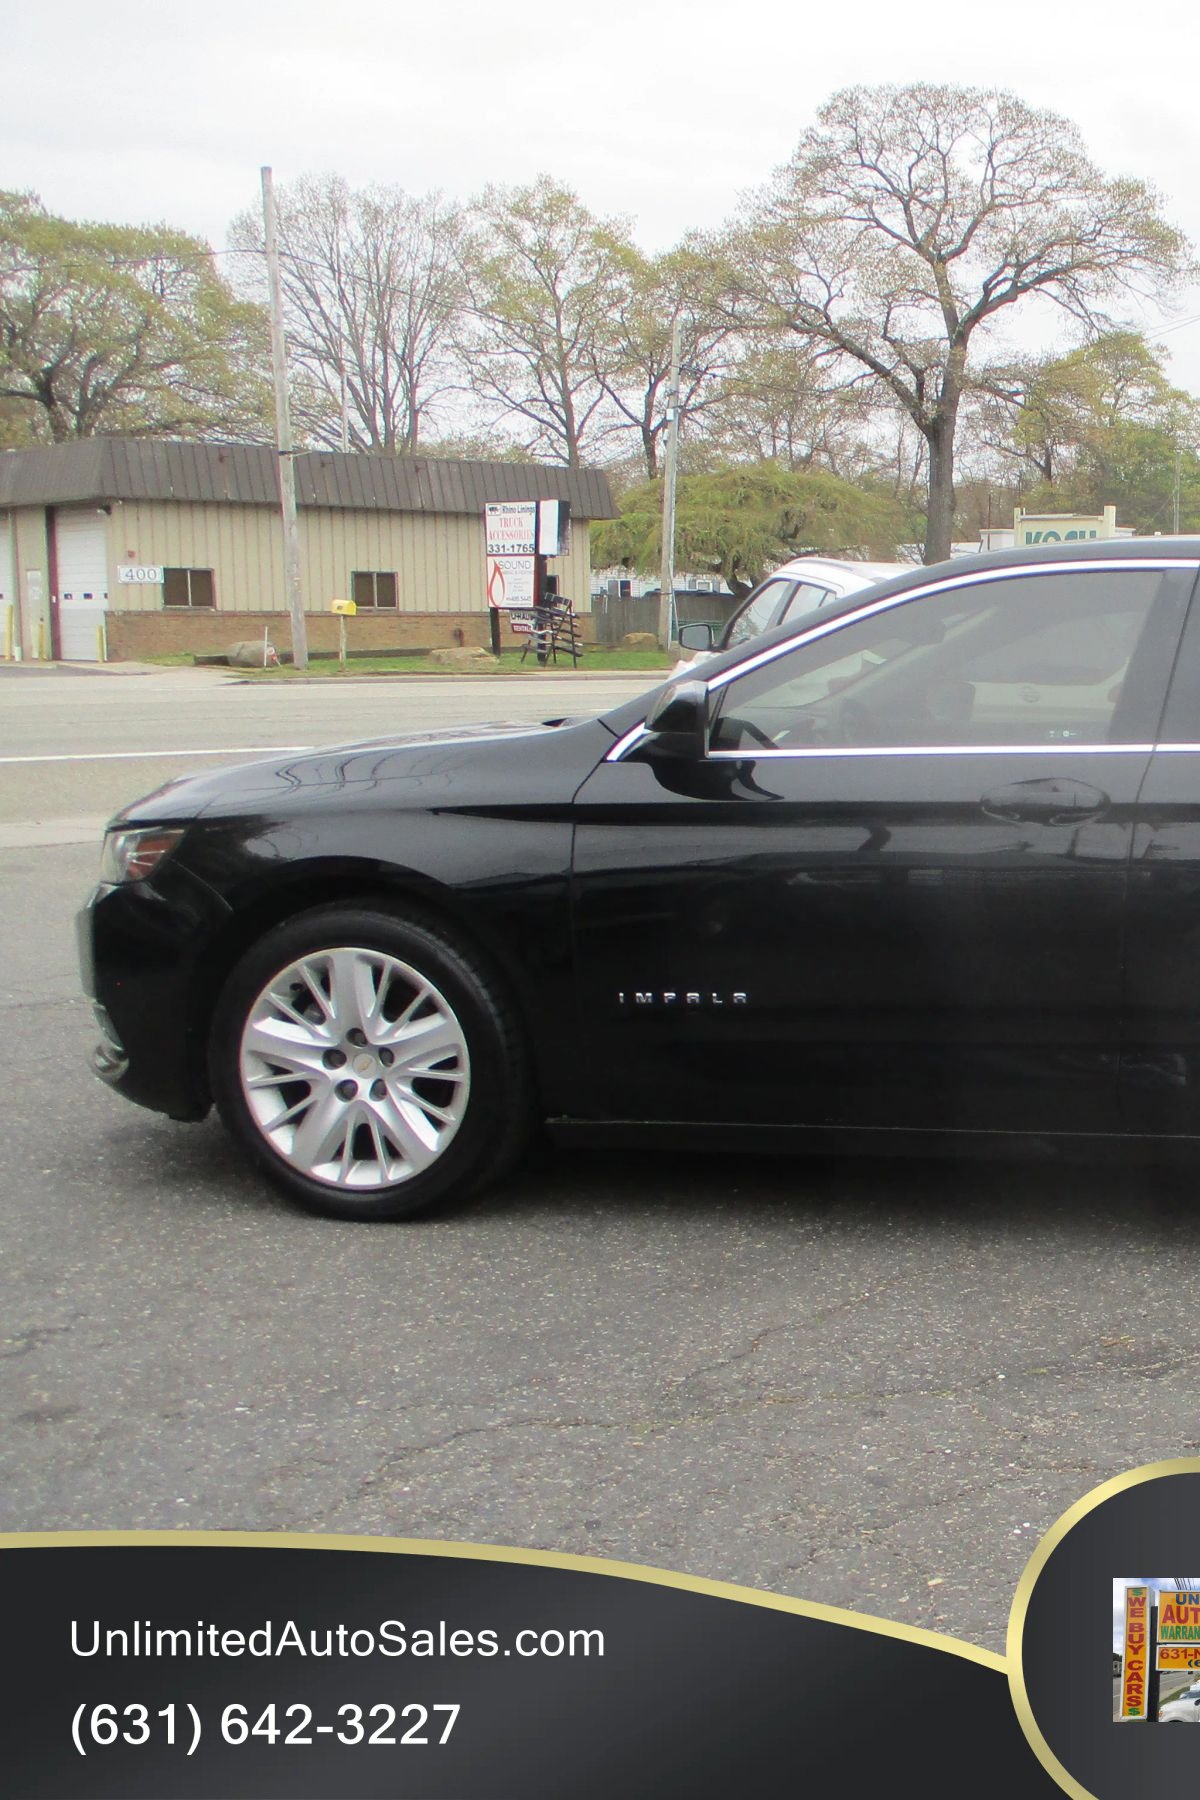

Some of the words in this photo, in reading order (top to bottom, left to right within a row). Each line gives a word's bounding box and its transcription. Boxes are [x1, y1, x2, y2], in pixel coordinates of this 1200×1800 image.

[500, 517, 524, 528] TRUCK
[488, 529, 535, 540] ACCESSORIES
[488, 543, 535, 553] 331-1765
[498, 560, 531, 570] SOUND
[125, 568, 158, 580] 400
[619, 992, 747, 1004] IMPALA
